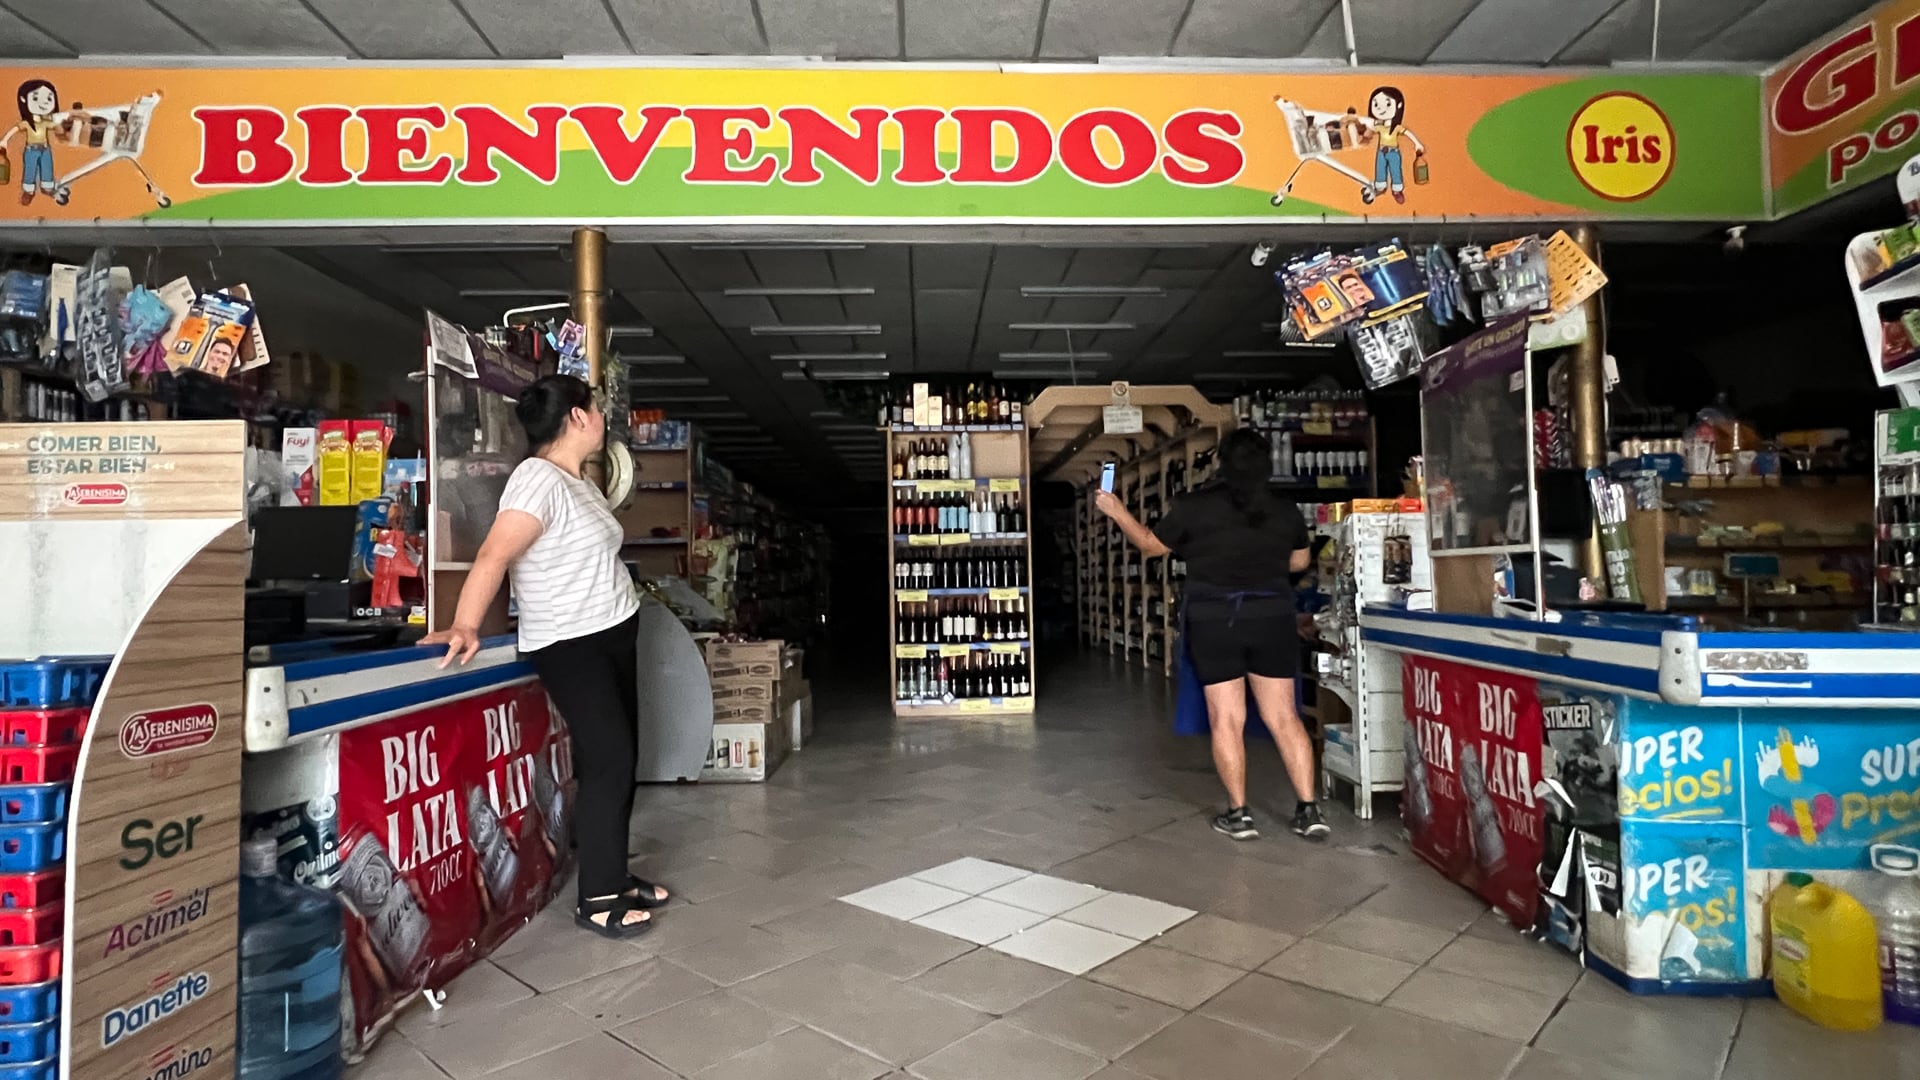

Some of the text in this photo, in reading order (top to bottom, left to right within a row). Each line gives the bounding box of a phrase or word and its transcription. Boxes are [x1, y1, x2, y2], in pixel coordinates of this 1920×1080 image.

[192, 105, 1244, 187] BIENVENIDOS
[1583, 125, 1661, 163] Iris
[26, 435, 162, 454] COMER BIEN,
[26, 457, 147, 475] ESTAR BIEN
[356, 608, 382, 616] OCB
[1413, 666, 1442, 716] BIG
[1477, 681, 1519, 740] BIG
[1541, 704, 1592, 729] STICKER
[482, 699, 521, 763] BIG
[1416, 715, 1455, 773] LATA
[380, 724, 441, 804] BIG
[1480, 739, 1536, 808] LATA
[119, 814, 205, 870] Ser
[386, 789, 463, 872] LATA
[430, 850, 464, 896] 710CC
[103, 887, 210, 958] Actimel
[103, 974, 208, 1046] Danette
